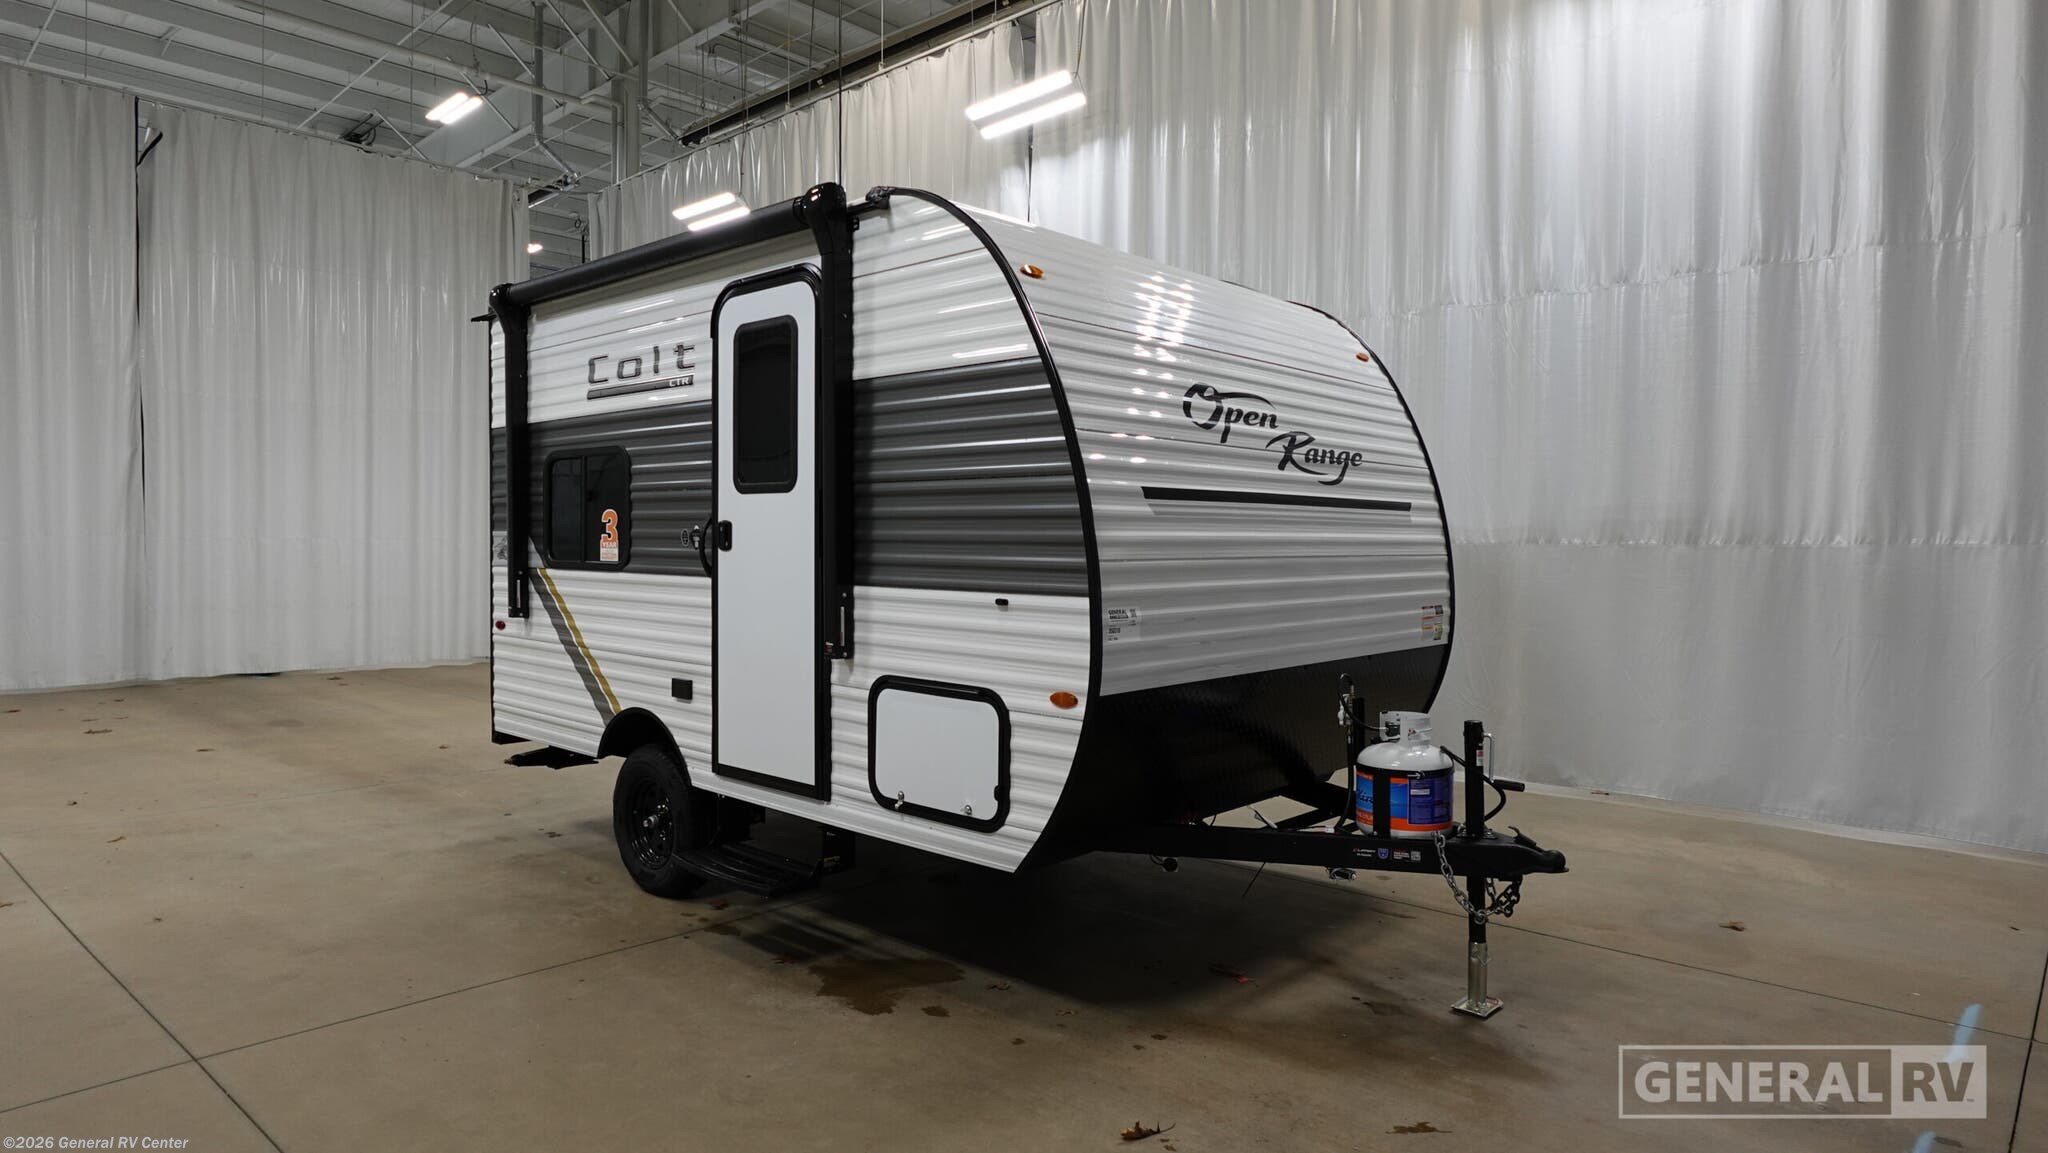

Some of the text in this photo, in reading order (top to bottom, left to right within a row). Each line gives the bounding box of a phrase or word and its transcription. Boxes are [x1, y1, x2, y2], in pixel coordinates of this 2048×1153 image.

[588, 343, 695, 384] Colt
[1182, 383, 1279, 444] Open
[1265, 431, 1363, 485] Range
[601, 509, 618, 542] 3
